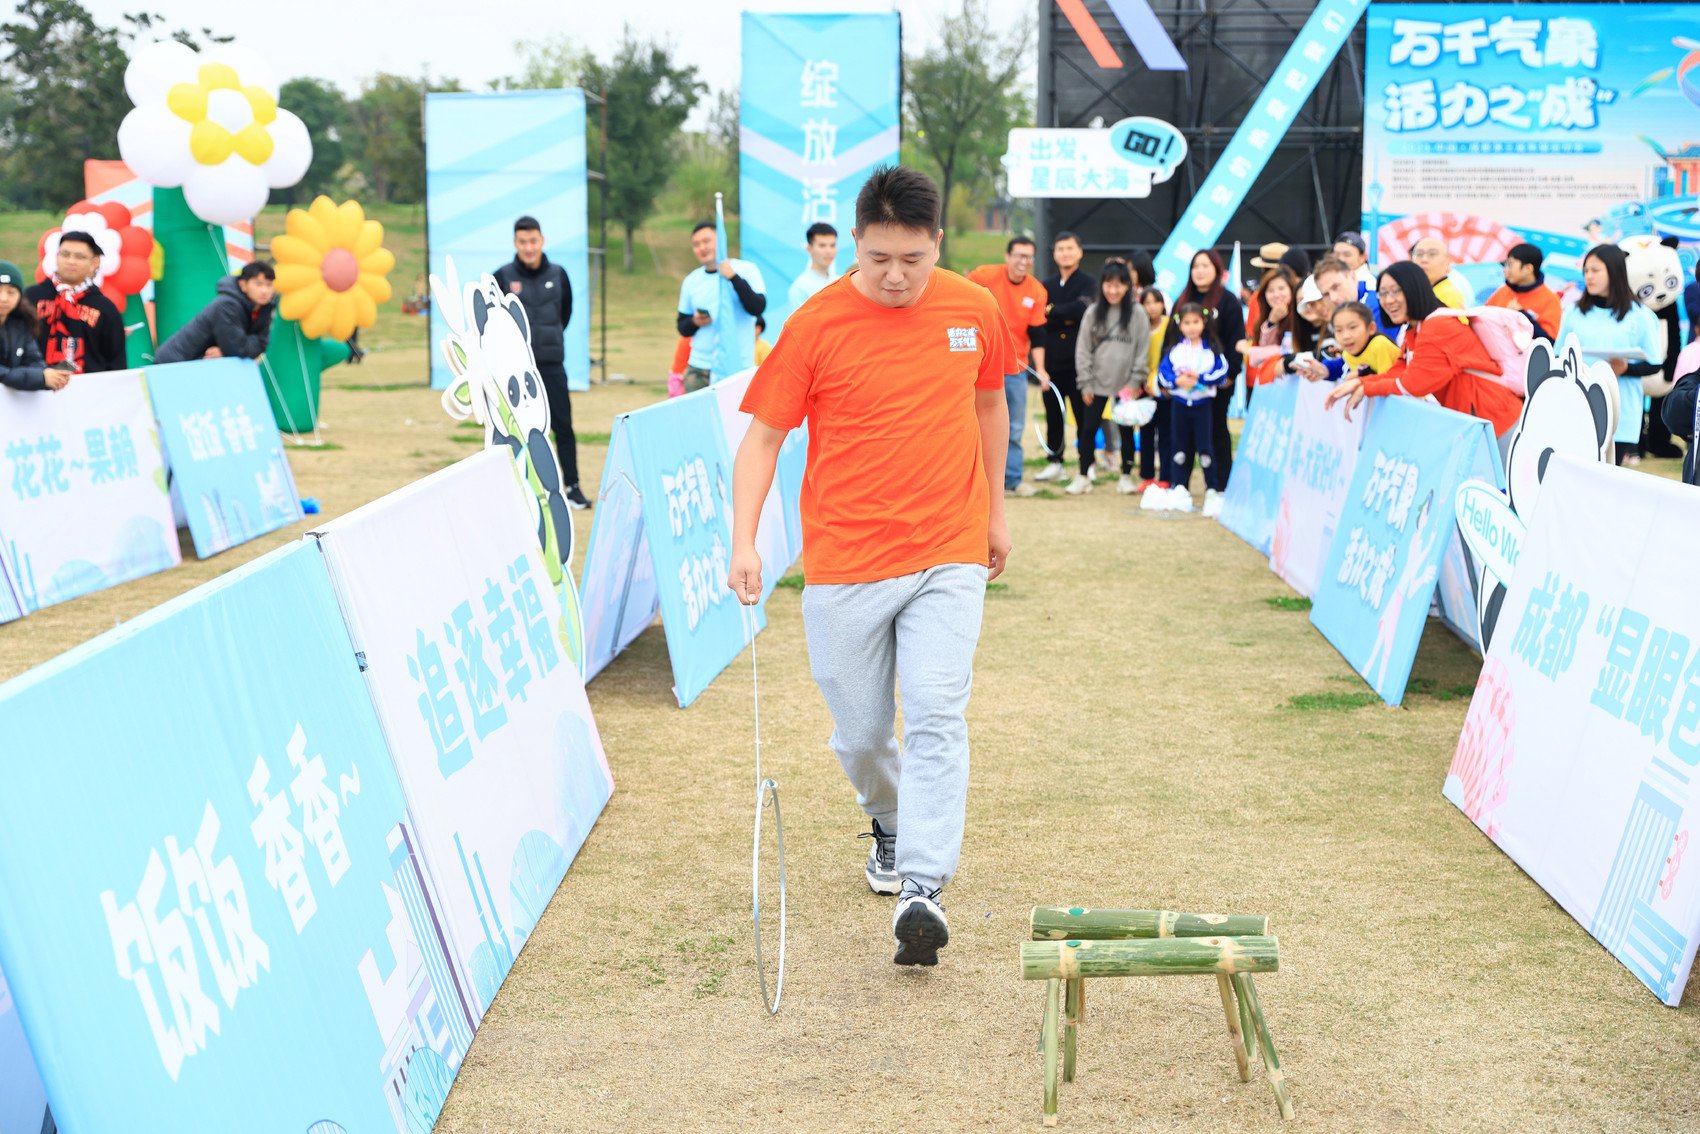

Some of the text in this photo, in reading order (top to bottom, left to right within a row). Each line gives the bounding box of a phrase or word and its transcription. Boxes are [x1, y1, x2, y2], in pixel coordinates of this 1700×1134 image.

[1389, 17, 1599, 68] 万千气象
[1124, 130, 1175, 164] GO!
[661, 457, 716, 538] 万千气象
[1362, 450, 1419, 533] 万千气象
[1462, 491, 1499, 548] Hello
[406, 553, 560, 781] 追逐幸福
